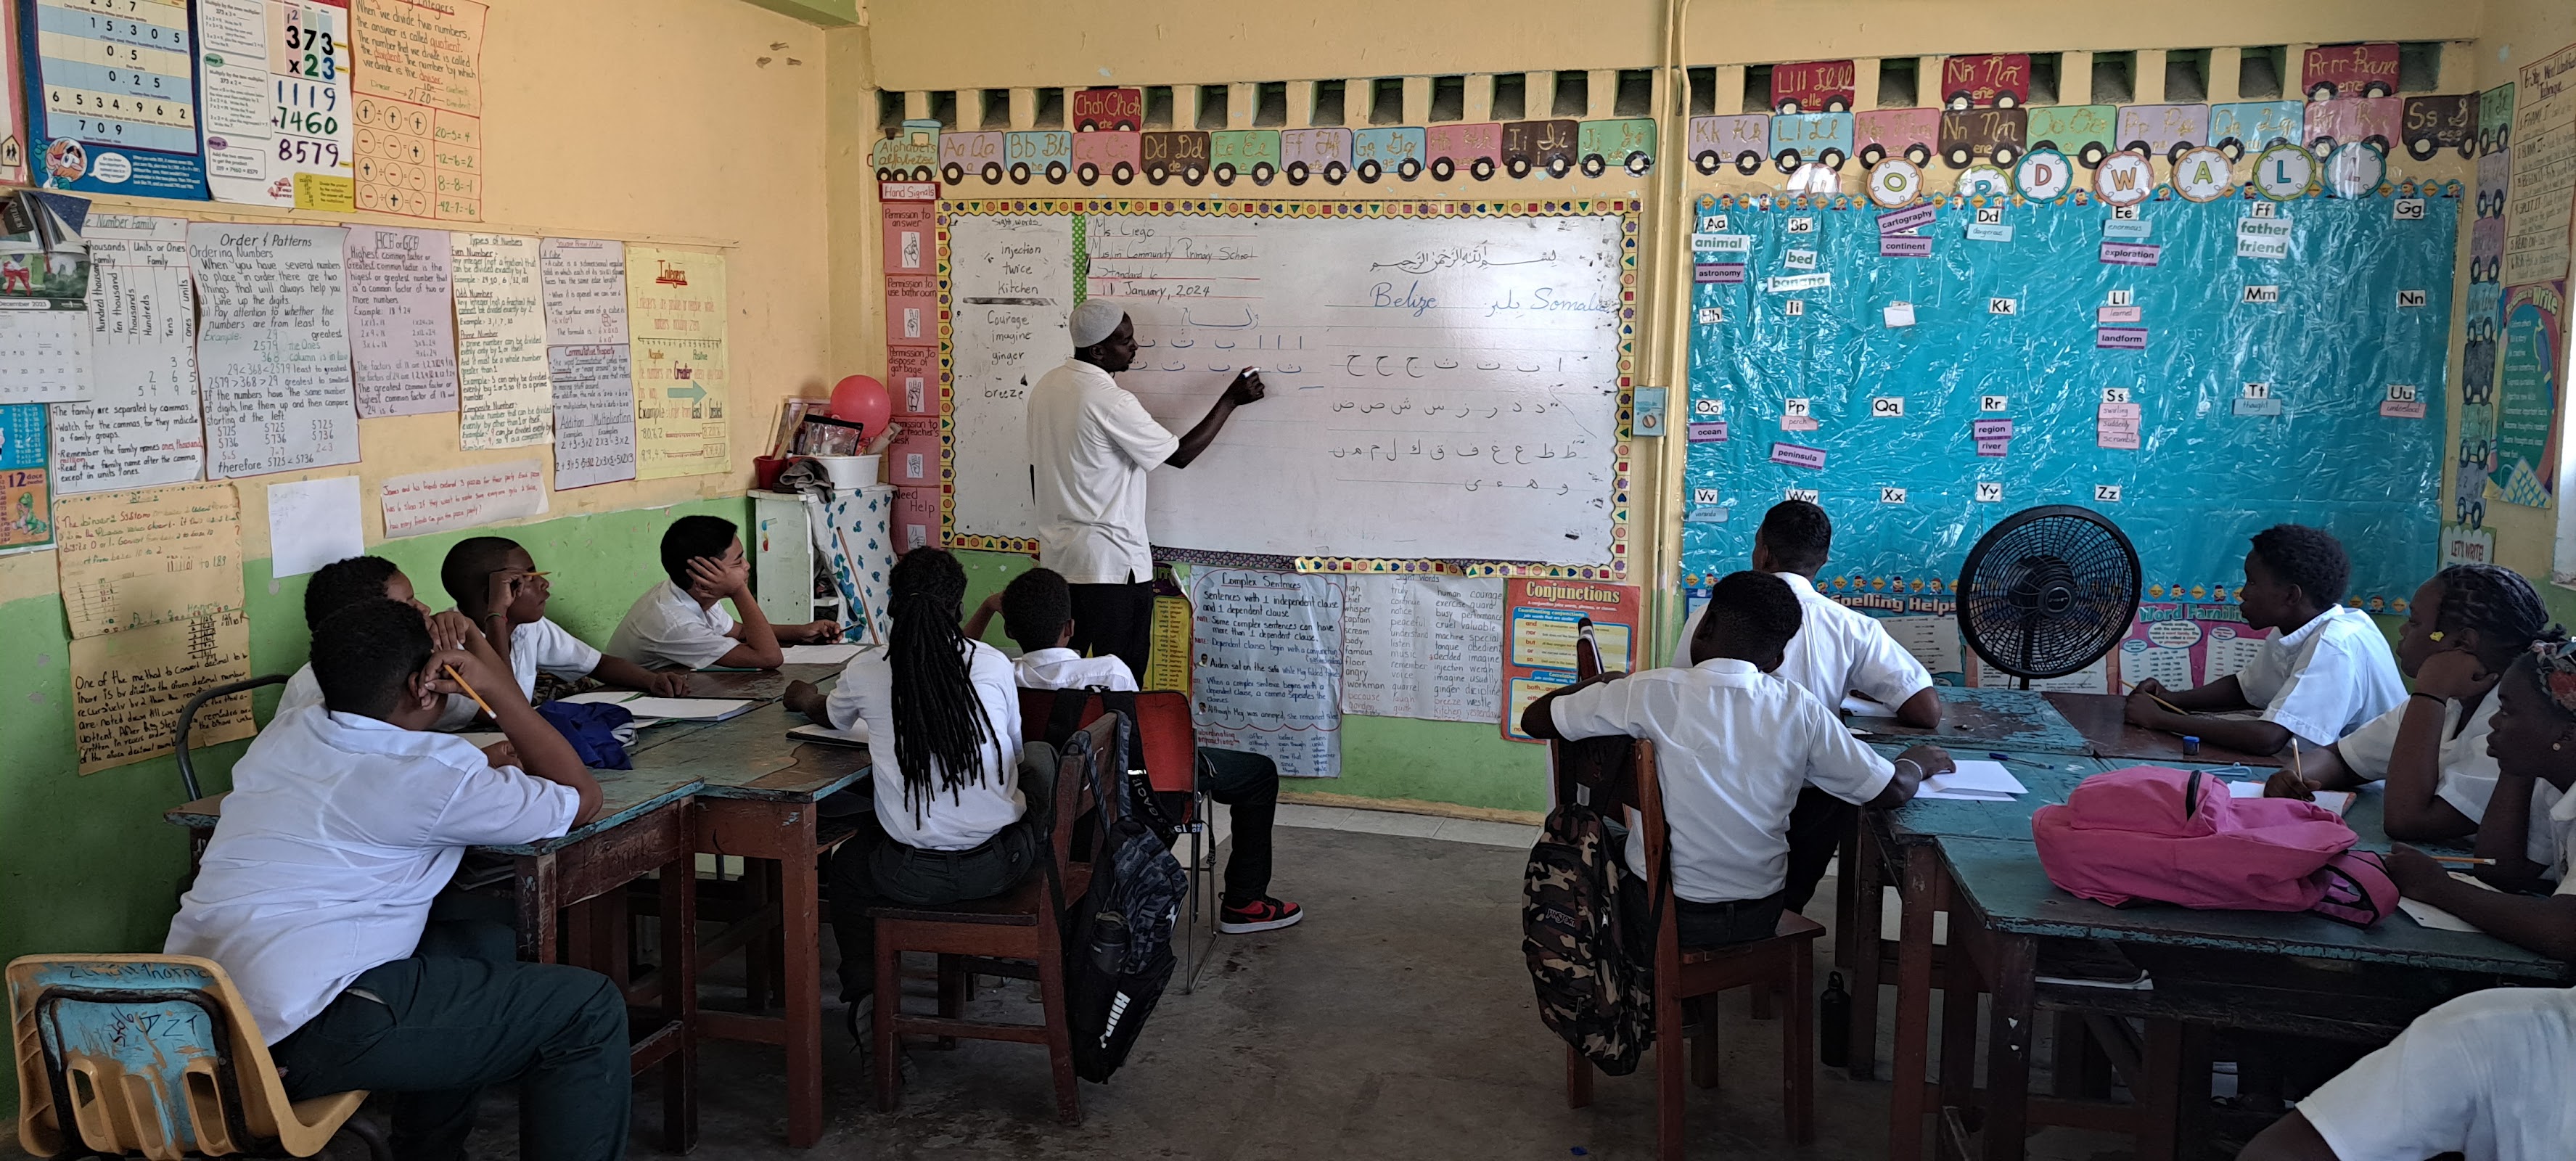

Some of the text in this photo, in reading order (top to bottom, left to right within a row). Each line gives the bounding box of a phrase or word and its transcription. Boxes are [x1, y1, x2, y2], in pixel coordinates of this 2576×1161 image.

[1972, 86, 1995, 99] eñe
[1801, 93, 1821, 107] elle
[1010, 134, 1036, 158] Bb
[1144, 136, 1167, 160] Dd
[885, 186, 935, 198] Hand Signals
[885, 208, 931, 221] Permission to
[2116, 207, 2132, 218] Ee
[2255, 204, 2271, 216] Ff
[2397, 202, 2421, 217] Gg
[1882, 210, 1932, 229] cartography
[1978, 210, 1998, 222] Dd
[97, 215, 157, 236] Number Family
[1705, 217, 1726, 229] Aa
[1791, 219, 1808, 231] Bb
[2241, 221, 2289, 235] father
[1120, 221, 1155, 244] Ciego
[134, 241, 186, 252] Units Ones
[221, 234, 312, 247] Order Patterns
[1694, 237, 1742, 249] animal
[1001, 241, 1041, 259] injection
[1219, 246, 1254, 260] School
[2239, 240, 2285, 254] friend
[189, 245, 273, 263] Ordering Numbers
[350, 246, 378, 263] Highest
[1787, 253, 1813, 266] bed
[2105, 249, 2154, 260] exploration
[201, 258, 313, 274] When you have several
[1004, 263, 1033, 275] twice
[1699, 270, 1741, 279] astronomy
[888, 278, 921, 289] Permission
[1176, 286, 1210, 296] 2024
[2247, 288, 2276, 300] Mm
[1370, 280, 1437, 316] Belize
[2113, 292, 2125, 304] Ll
[2400, 293, 2424, 304] Nn
[1789, 302, 1799, 313] Ii
[1992, 300, 2012, 312] Kk
[140, 295, 152, 336] Hundreds
[991, 331, 1031, 344] imagine
[2101, 335, 2142, 343] landform
[889, 347, 936, 359] Permission to
[992, 351, 1025, 365] ginger
[889, 358, 929, 369] dispose of
[891, 365, 922, 377] garbage
[984, 383, 1024, 399] breeze
[2107, 390, 2124, 402] Ss
[2249, 385, 2265, 397] Tt
[2391, 387, 2412, 398] Uu
[1697, 401, 1719, 414] Oo
[1789, 401, 1805, 415] Pp
[1875, 400, 1901, 414] Qq
[1985, 398, 2001, 409] Rr
[72, 403, 94, 418] family
[114, 403, 146, 417] separated
[1979, 425, 2006, 434] region
[1777, 448, 1817, 461] peninsula
[218, 459, 262, 472] therefore
[1698, 491, 1715, 501] Vv
[1884, 490, 1903, 501] Xx
[1980, 485, 1999, 499] Yy
[2098, 487, 2117, 499] Zz
[910, 501, 935, 518] Help
[1222, 573, 1301, 588] Complex Sentences
[1391, 585, 1408, 600] truly
[1437, 586, 1461, 597] human
[1526, 581, 1620, 603] Conjunctions
[1244, 592, 1260, 603] with
[1273, 594, 1316, 609] independent
[1318, 597, 1339, 608] clause
[1203, 603, 1289, 618] and dependent clause
[1436, 610, 1453, 622] busy
[2138, 605, 2183, 623] Word
[1391, 618, 1426, 627] peaceful
[1345, 636, 1363, 648] body
[1391, 639, 1411, 647] listen
[1345, 647, 1372, 656] famous
[1345, 669, 1368, 681] angry
[1435, 686, 1460, 697] ginger
